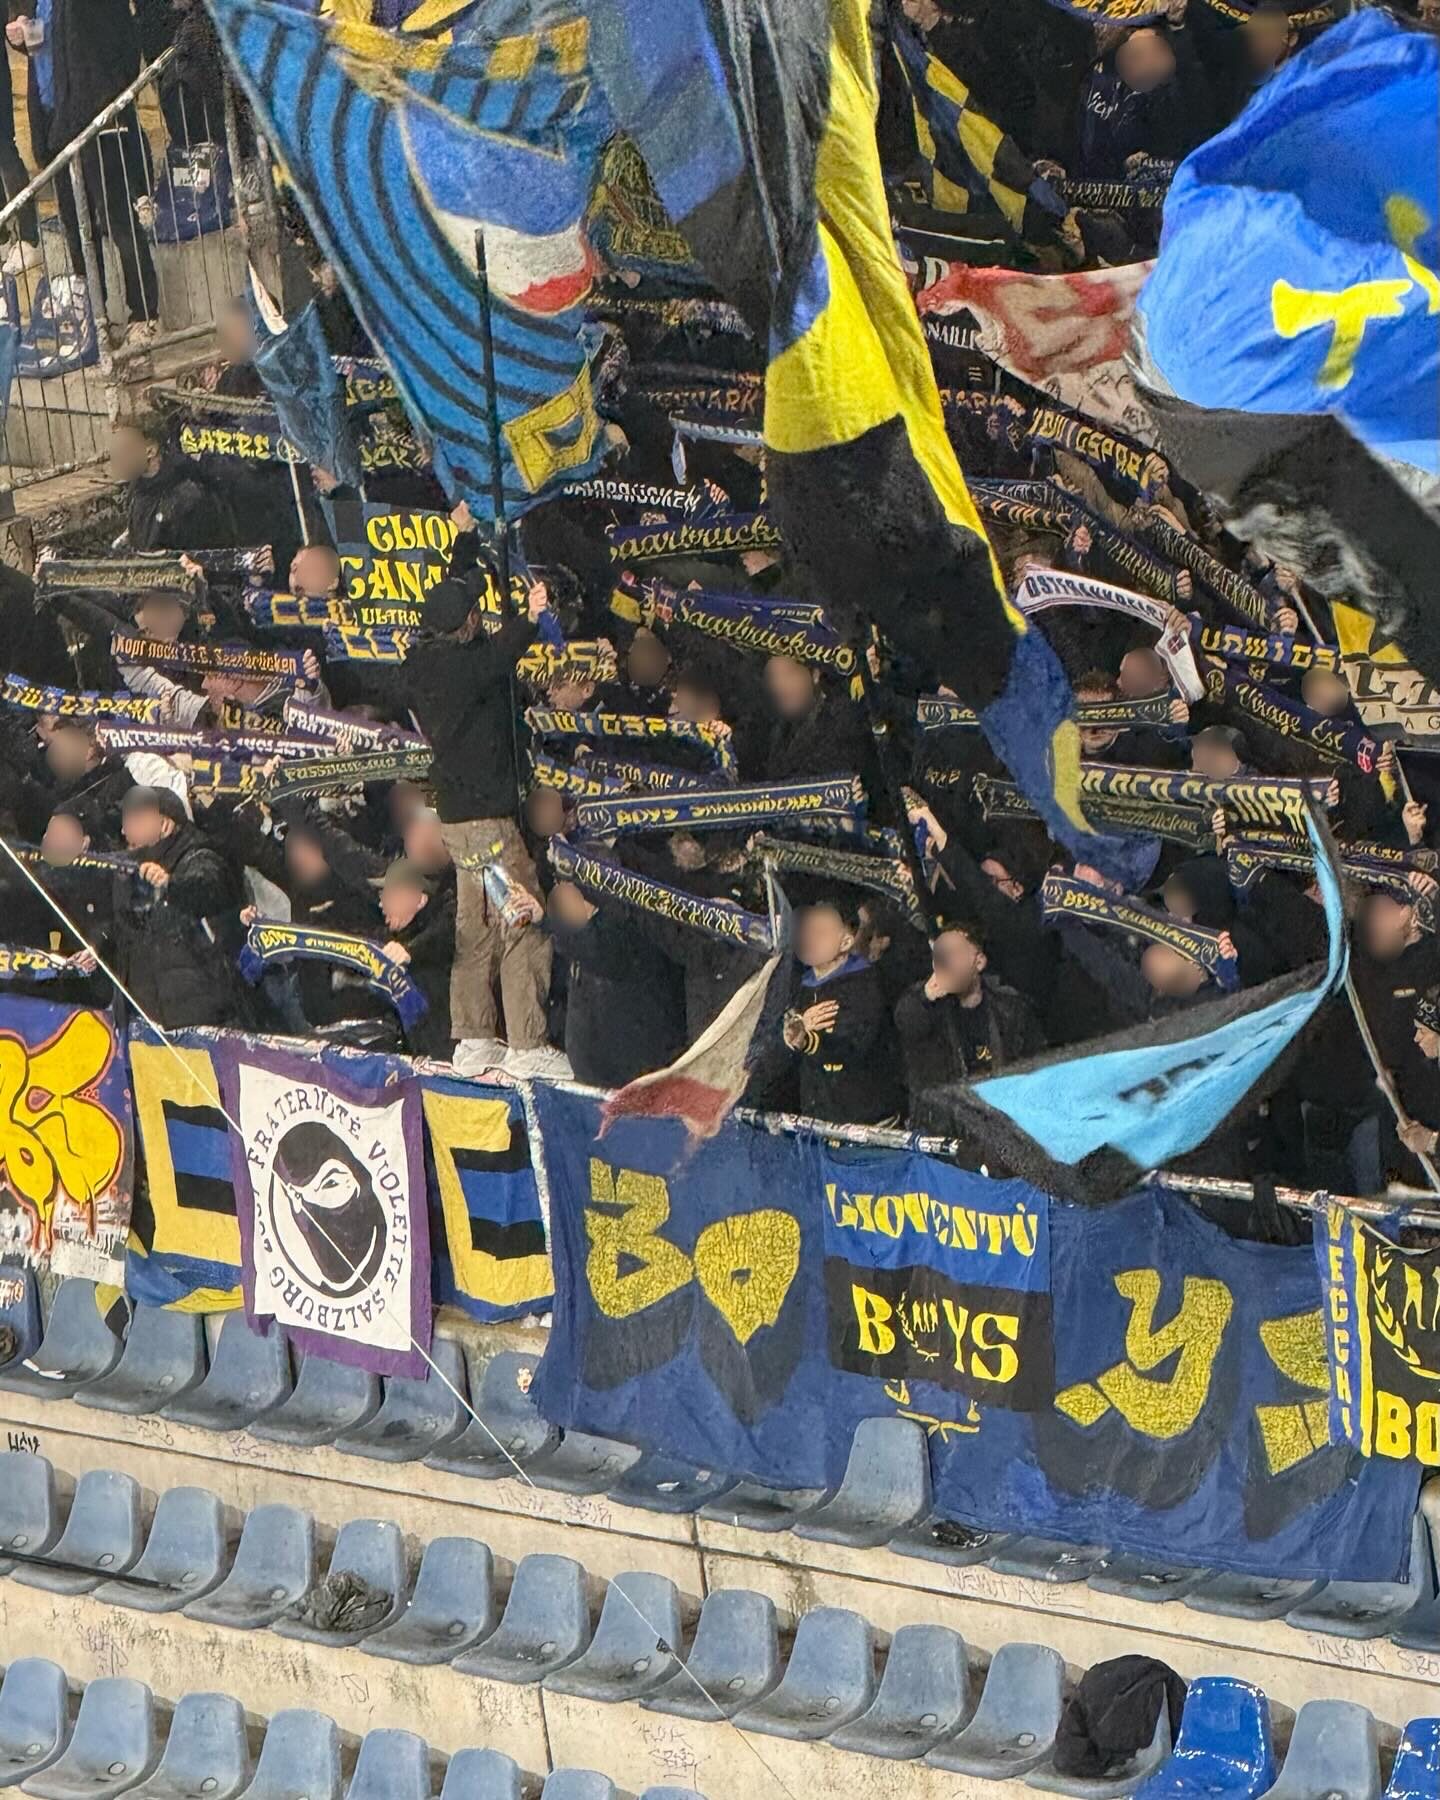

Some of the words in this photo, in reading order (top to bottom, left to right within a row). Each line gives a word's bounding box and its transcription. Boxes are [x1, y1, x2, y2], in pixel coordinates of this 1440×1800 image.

[367, 513, 457, 564] CLIQ
[611, 514, 784, 563] aarbrück
[361, 608, 422, 626] ULTRA
[1235, 682, 1302, 735] Virage
[247, 1087, 361, 1170] FRATERNITÉ
[368, 1139, 408, 1294] VIOLETTE
[824, 1183, 1039, 1257] GIOVENTÙ
[269, 1264, 387, 1332] SALZBURG
[1326, 1200, 1353, 1440] VECCHI
